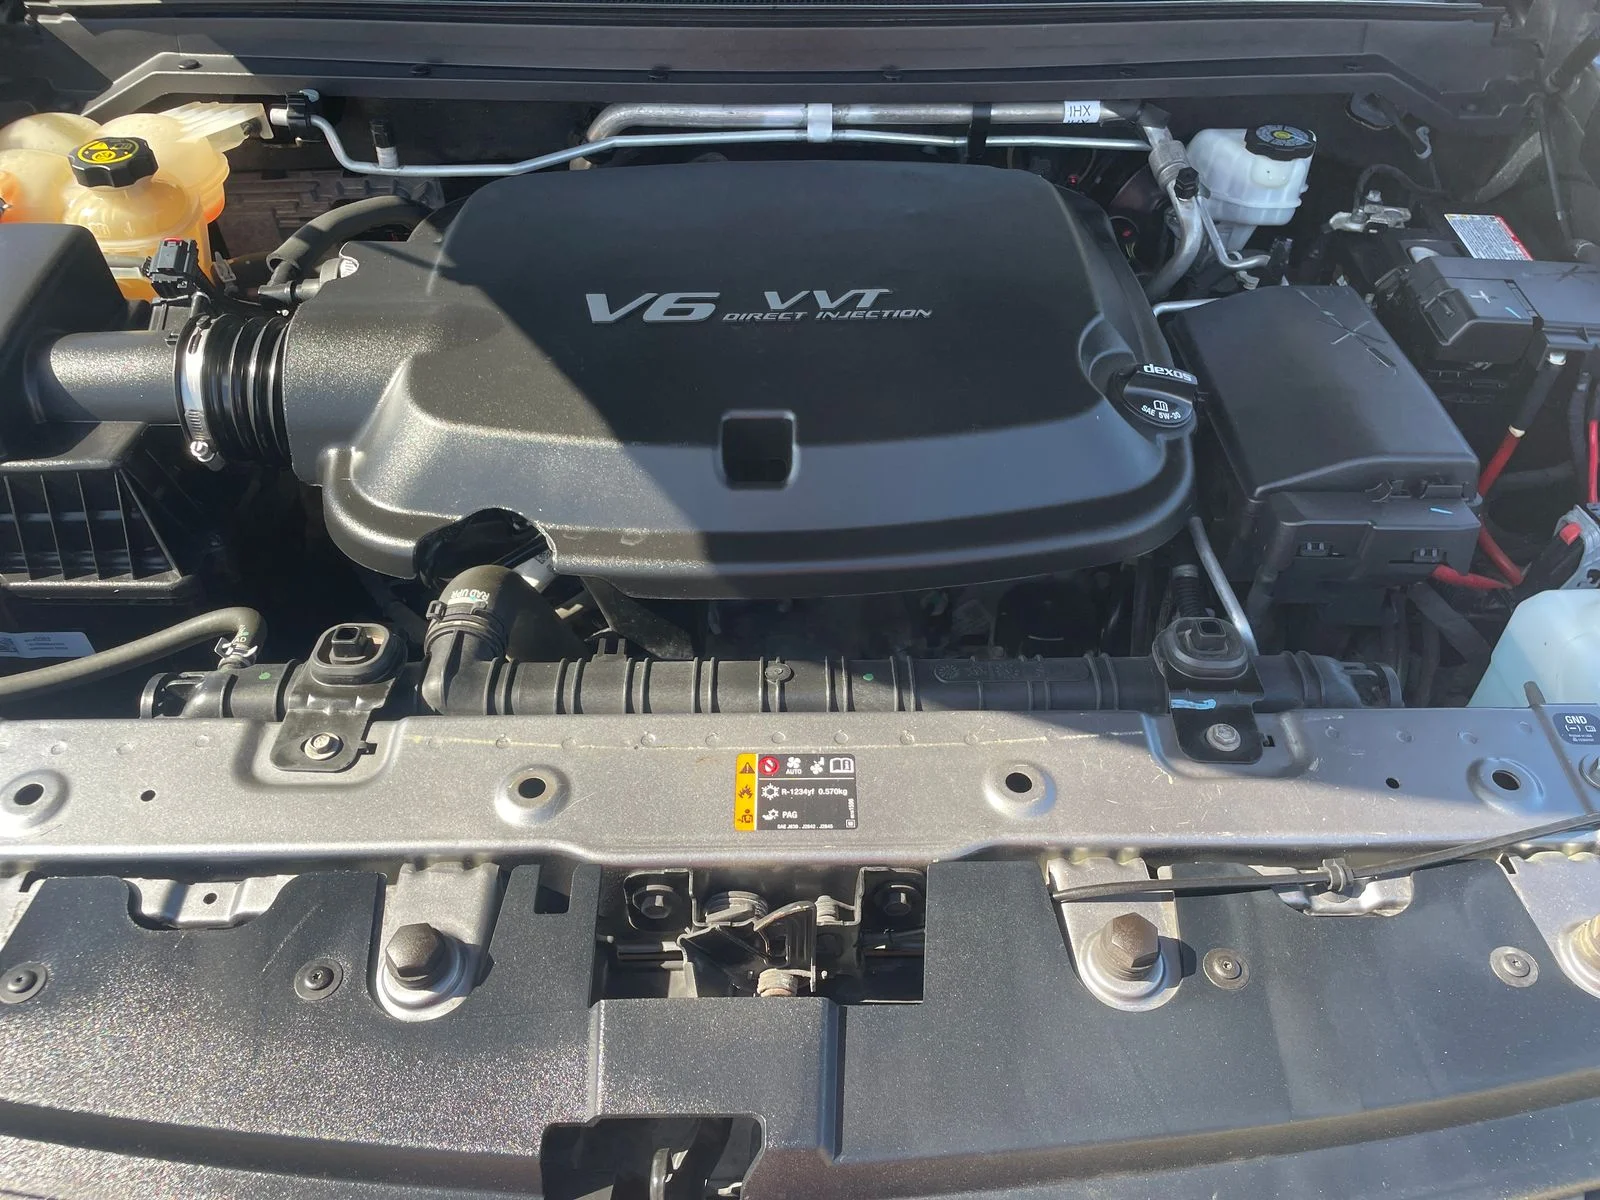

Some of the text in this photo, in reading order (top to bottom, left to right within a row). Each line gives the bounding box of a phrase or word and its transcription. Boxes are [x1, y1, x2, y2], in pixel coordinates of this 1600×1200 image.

[585, 288, 891, 323] V6 VVT
[722, 309, 933, 321] DIRECT INJECTION
[1143, 364, 1192, 381] dexos
[1141, 404, 1181, 420] SAE 5W-30
[470, 589, 490, 601] RAD
[1565, 715, 1587, 724] GND
[781, 788, 848, 797] R-1234yf 0.570kg
[782, 811, 798, 819] PAG
